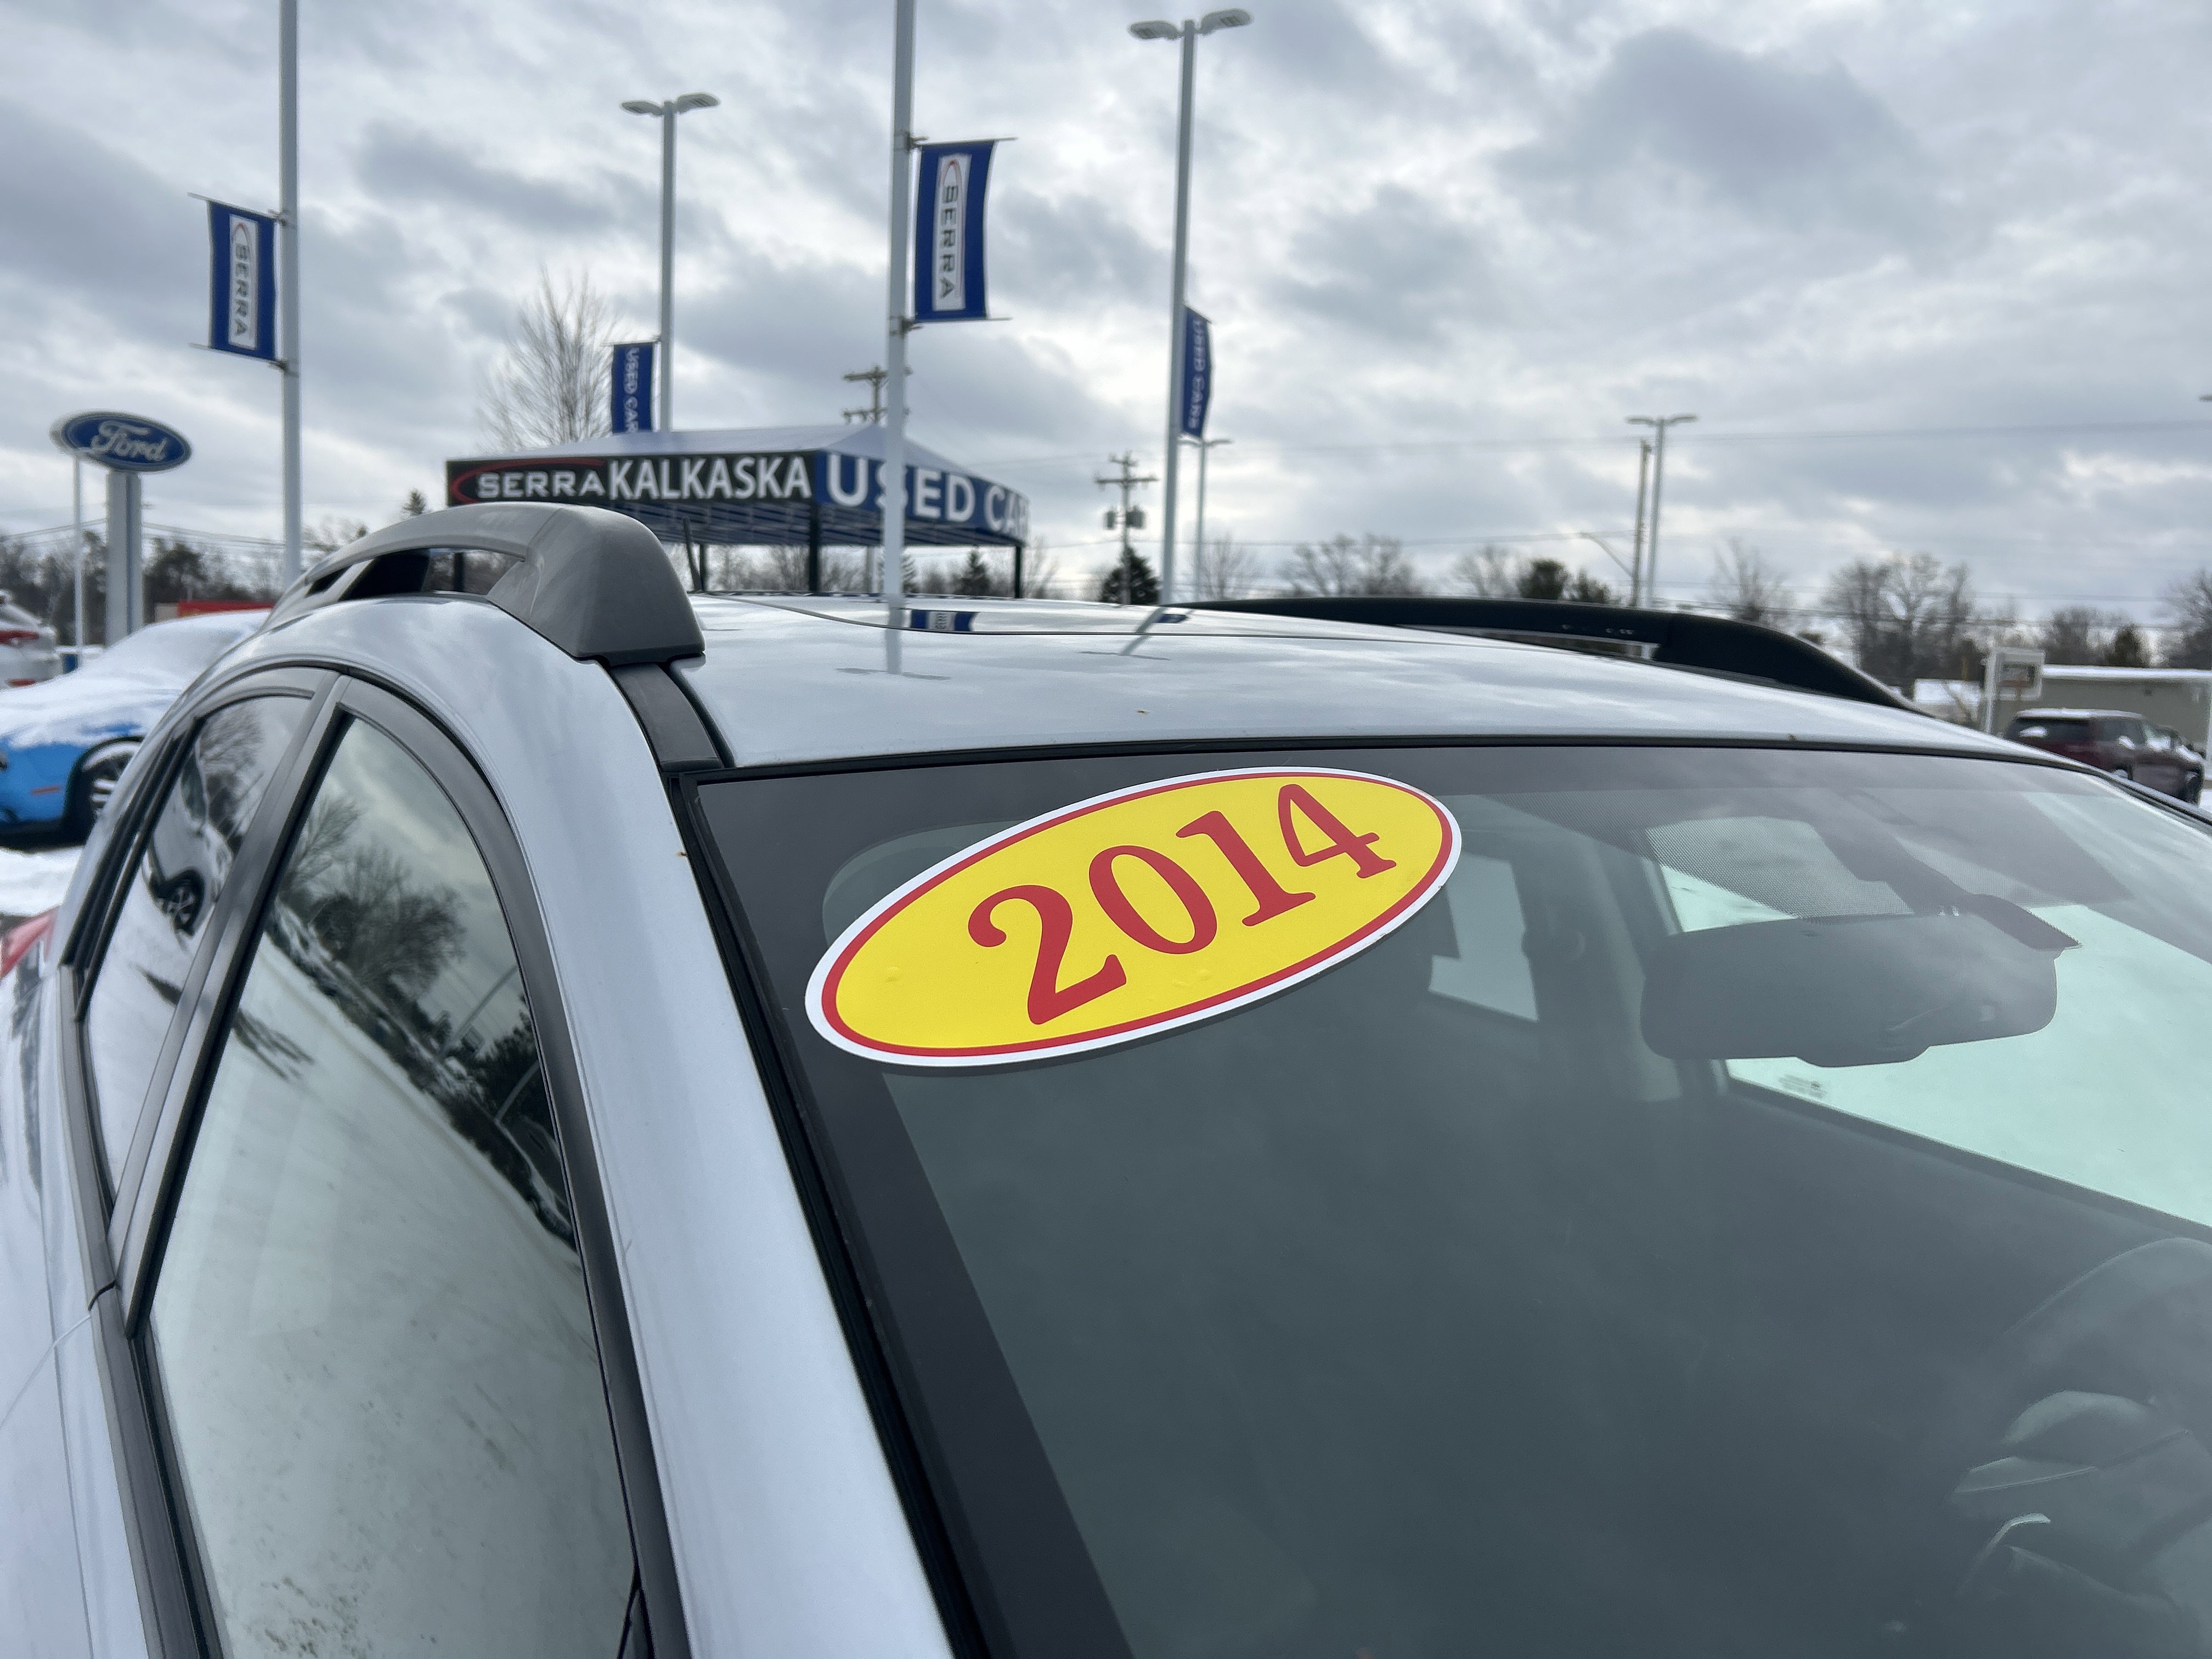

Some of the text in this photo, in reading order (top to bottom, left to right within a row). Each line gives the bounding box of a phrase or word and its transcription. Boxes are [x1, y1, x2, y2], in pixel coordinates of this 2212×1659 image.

[939, 184, 958, 299] SERRA
[234, 242, 249, 336] SERRA
[624, 347, 639, 433] USED CAR
[90, 420, 167, 462] Ford
[477, 470, 605, 499] SERRA
[608, 455, 812, 500] KALKASKA
[967, 783, 1397, 1026] 2014
